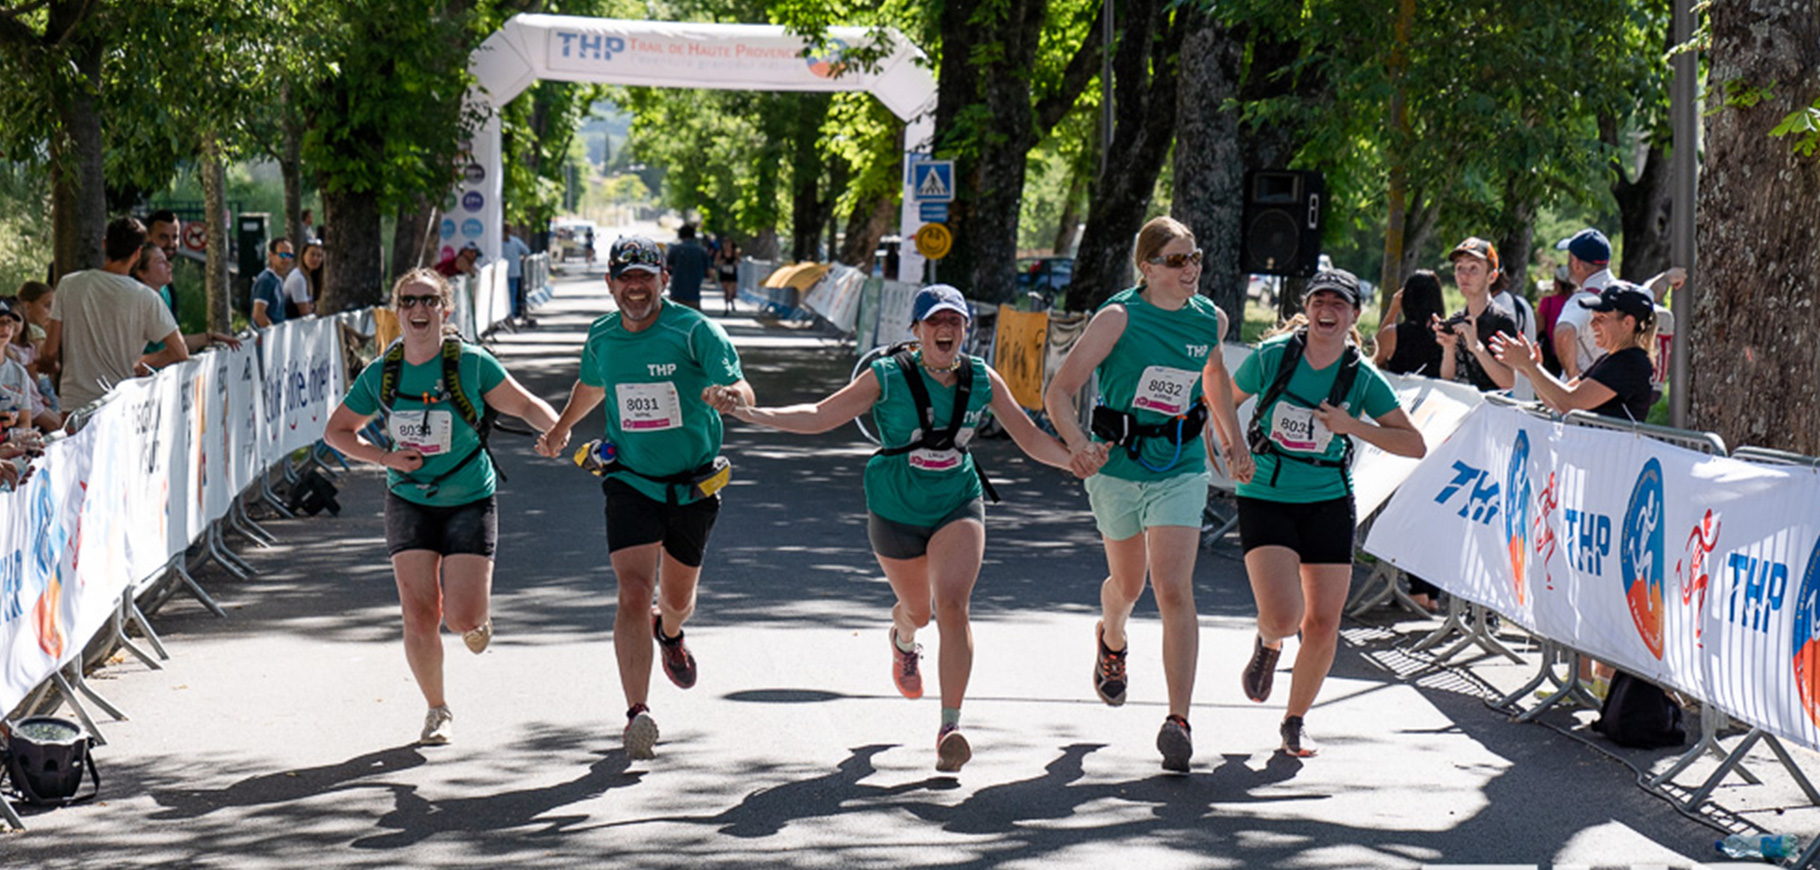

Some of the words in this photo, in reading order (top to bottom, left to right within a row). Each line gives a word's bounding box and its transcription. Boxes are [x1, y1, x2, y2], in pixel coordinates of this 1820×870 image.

[557, 32, 625, 61] THP
[647, 363, 677, 376] THP
[1148, 379, 1182, 397] 8032
[626, 397, 660, 411] 8031
[1281, 417, 1312, 435] 803
[1565, 508, 1612, 577] THP
[1728, 552, 1788, 635] THP
